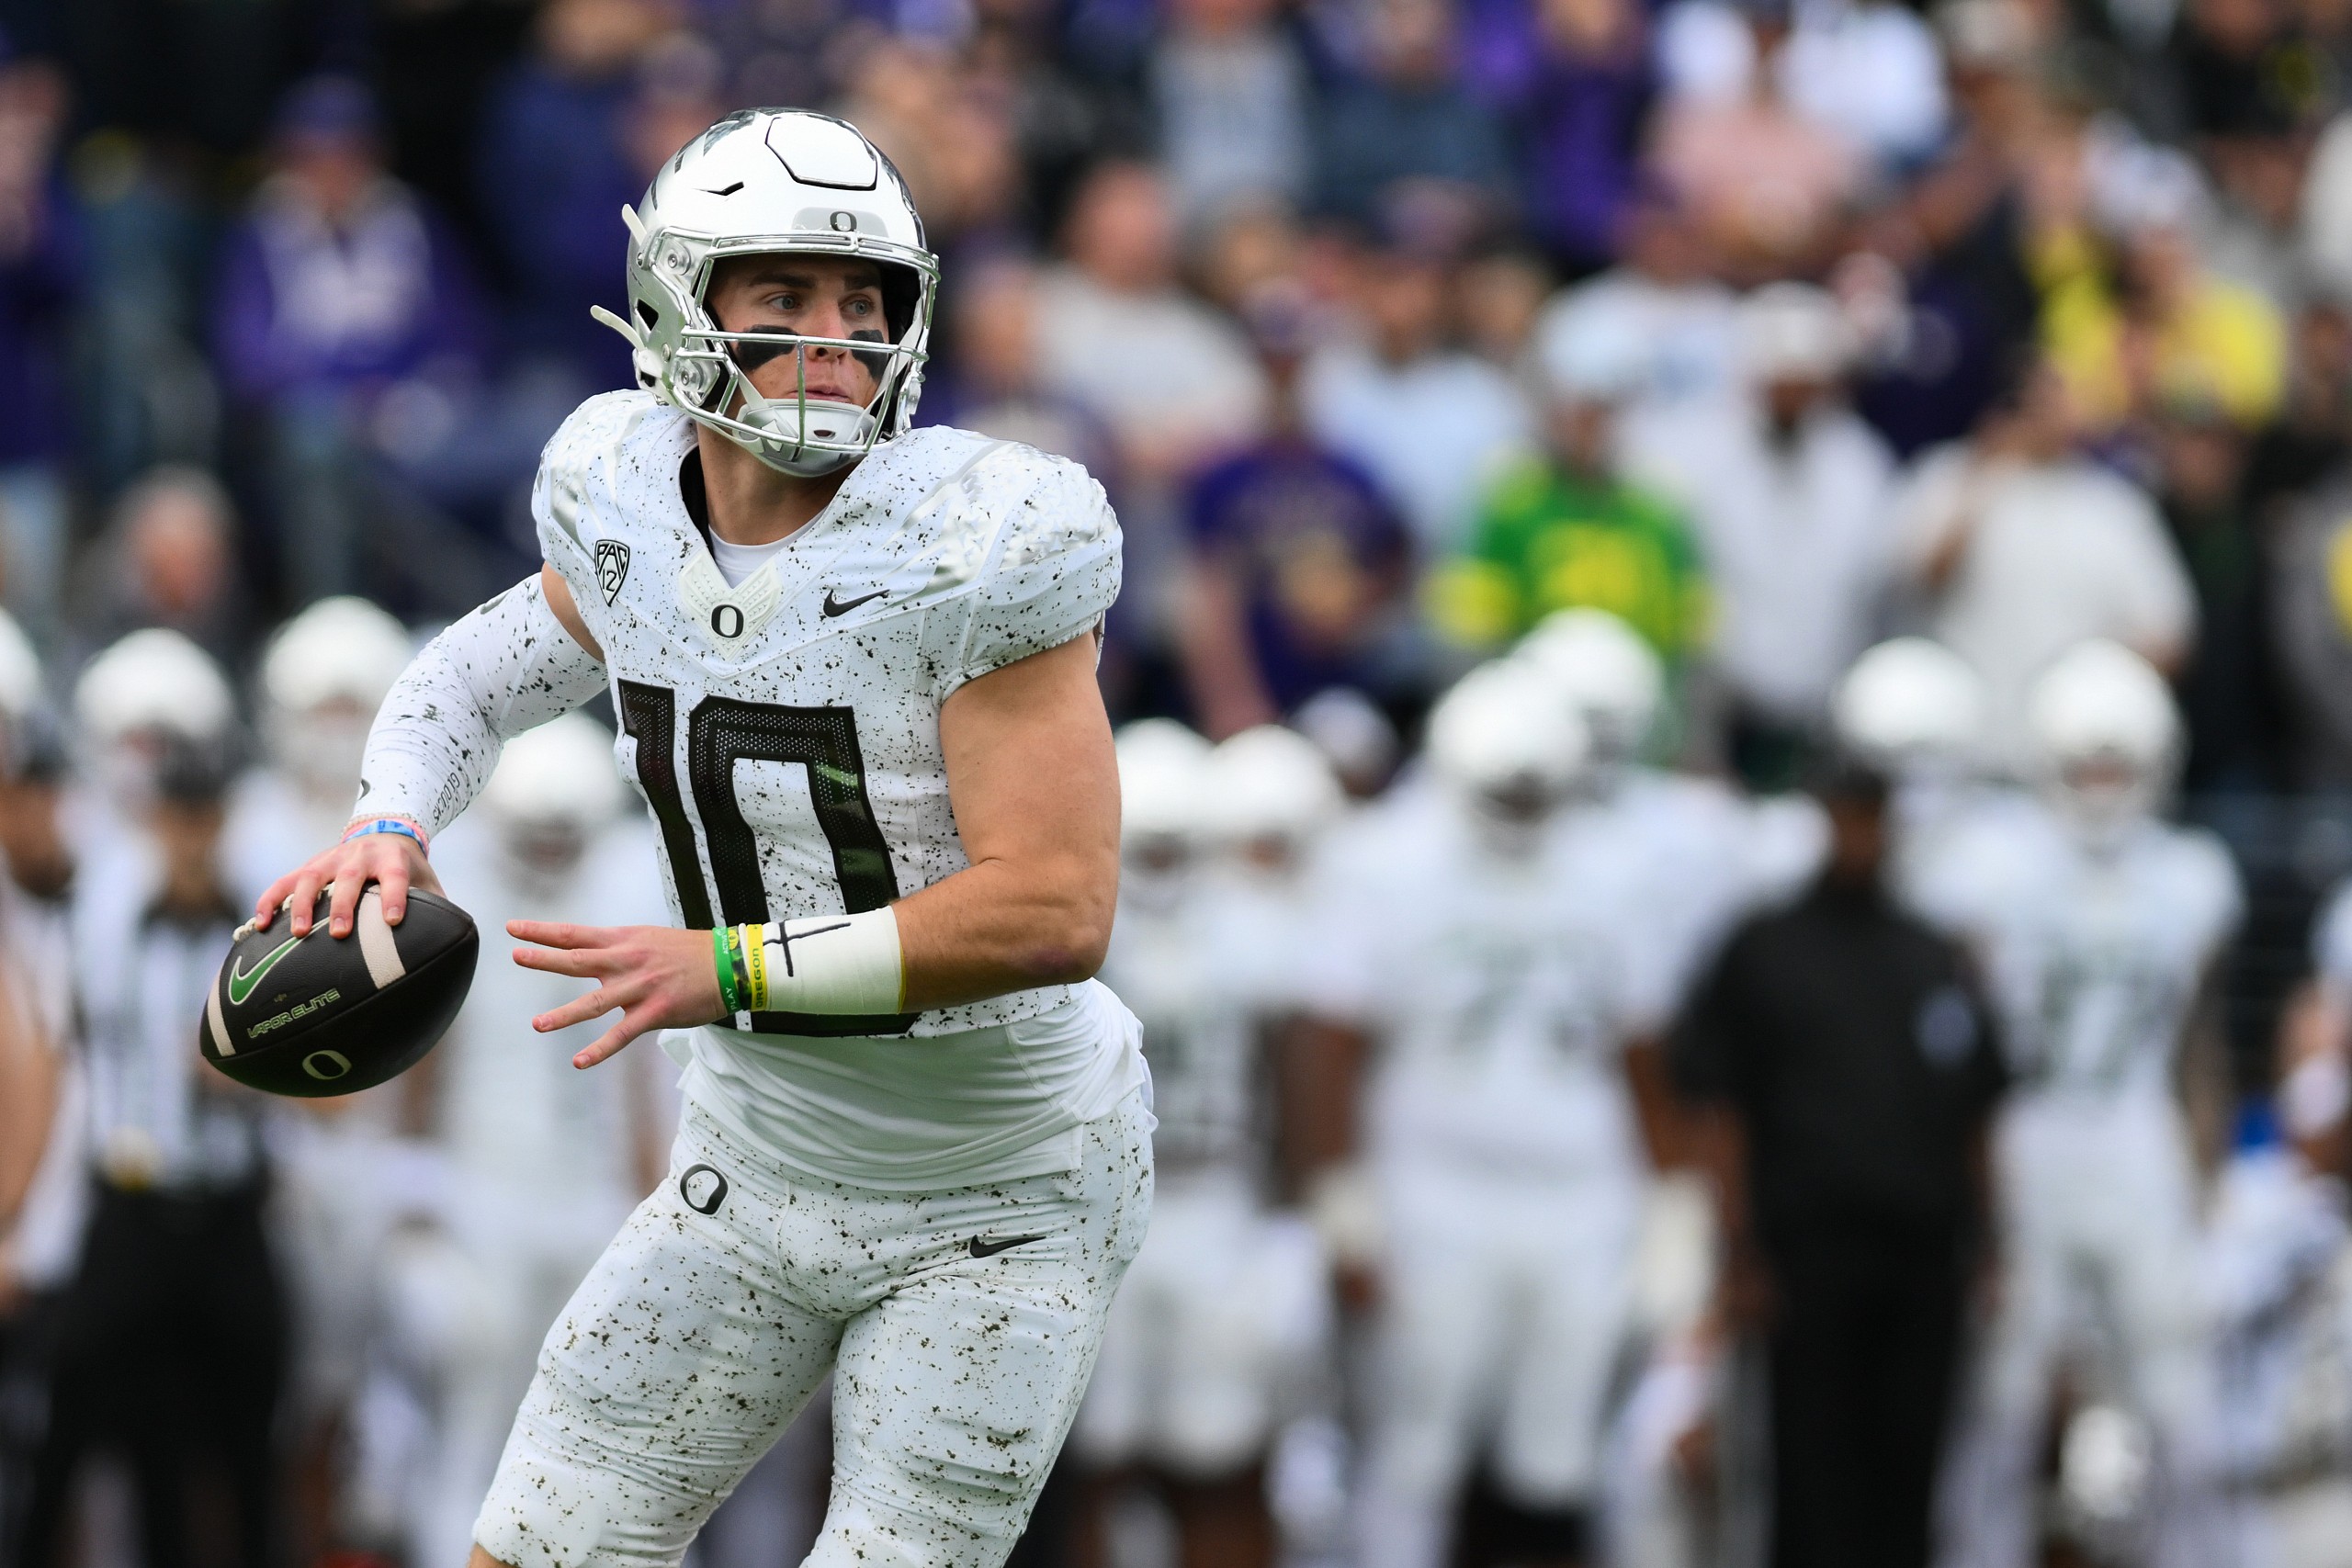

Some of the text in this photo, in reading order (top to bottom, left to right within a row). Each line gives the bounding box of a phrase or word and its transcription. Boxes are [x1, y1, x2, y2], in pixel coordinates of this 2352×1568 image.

[830, 211, 857, 231] O
[597, 543, 627, 581] PAC
[602, 569, 616, 592] 12
[710, 604, 744, 638] O
[617, 678, 921, 1037] 10
[752, 947, 764, 1008] OREGON
[247, 987, 341, 1038] VAPOR ELITE
[725, 987, 738, 1010] PLAY
[301, 1050, 352, 1080] O
[680, 1163, 729, 1215] O
